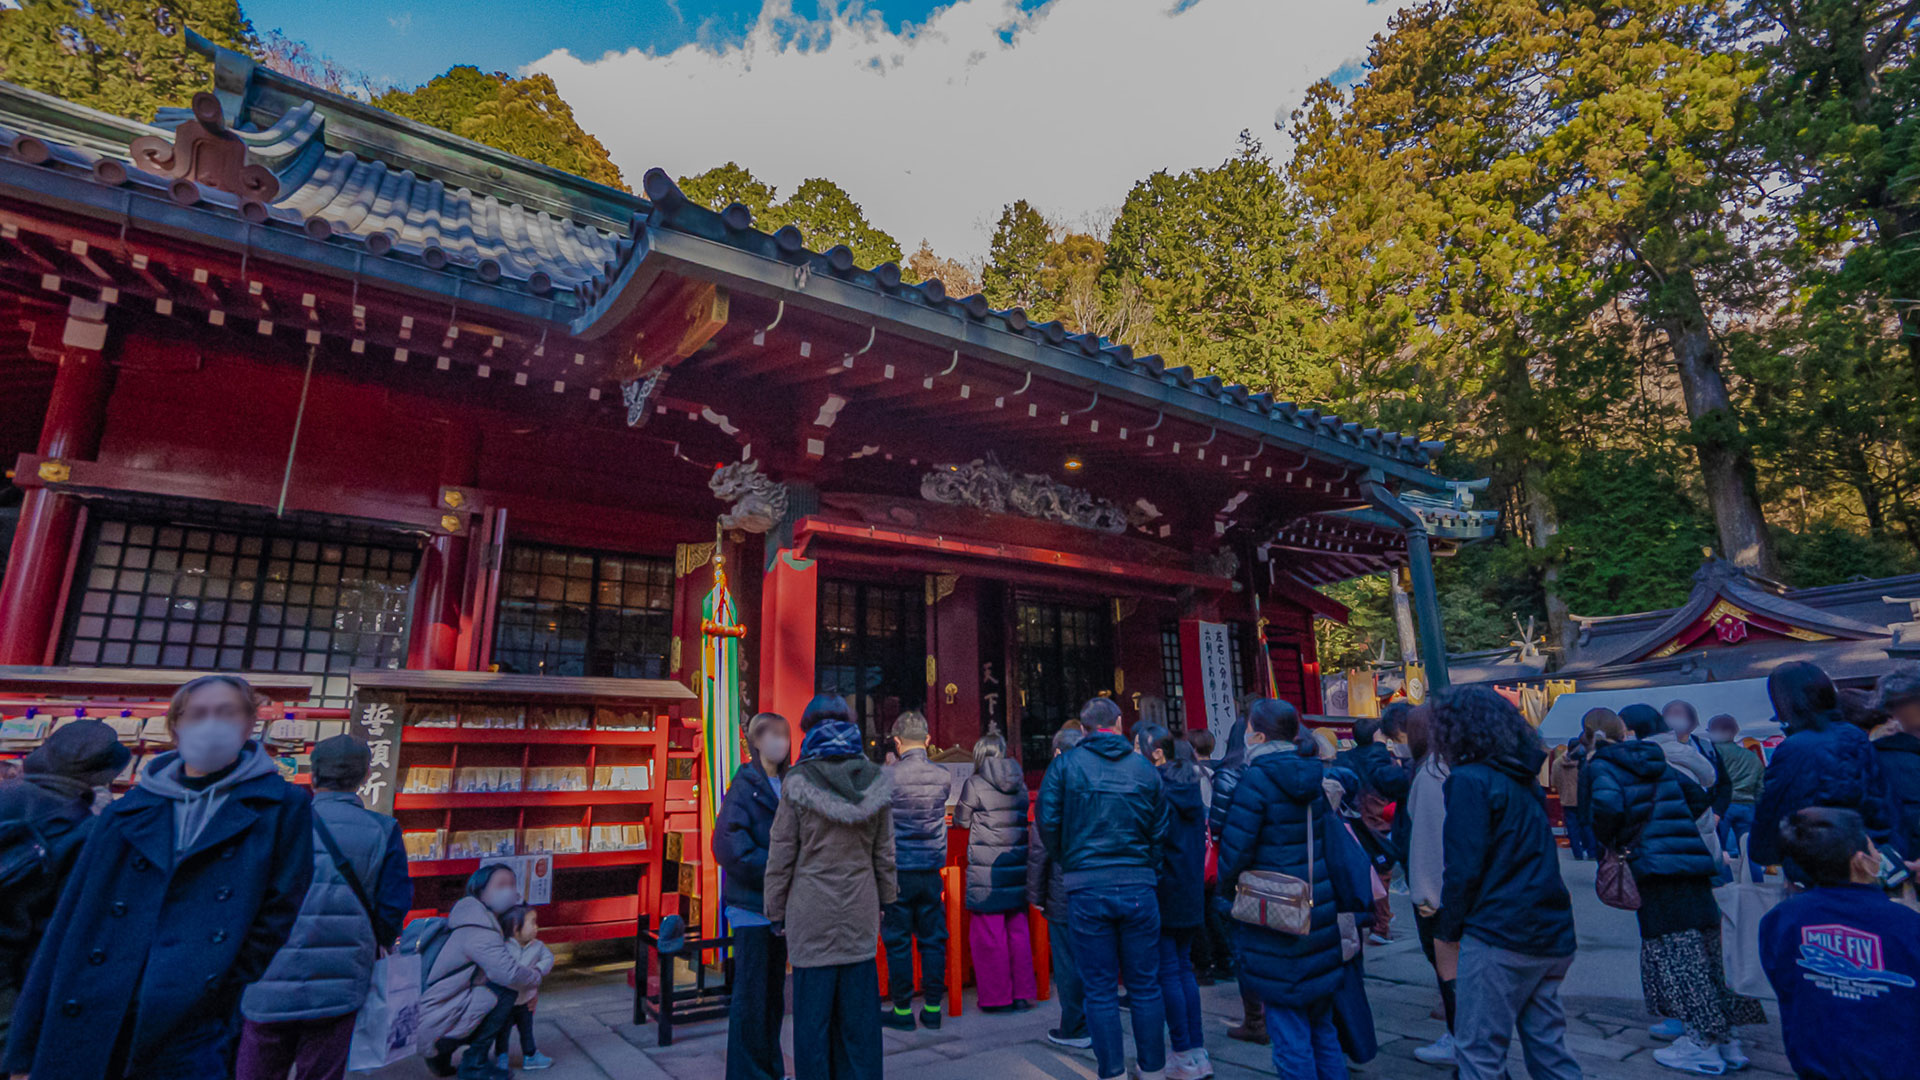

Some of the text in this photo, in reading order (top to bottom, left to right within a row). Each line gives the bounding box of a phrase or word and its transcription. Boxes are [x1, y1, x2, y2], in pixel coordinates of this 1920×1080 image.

[1215, 631, 1231, 718] 左右に分かれて
[1807, 931, 1873, 966] MILE FLY
